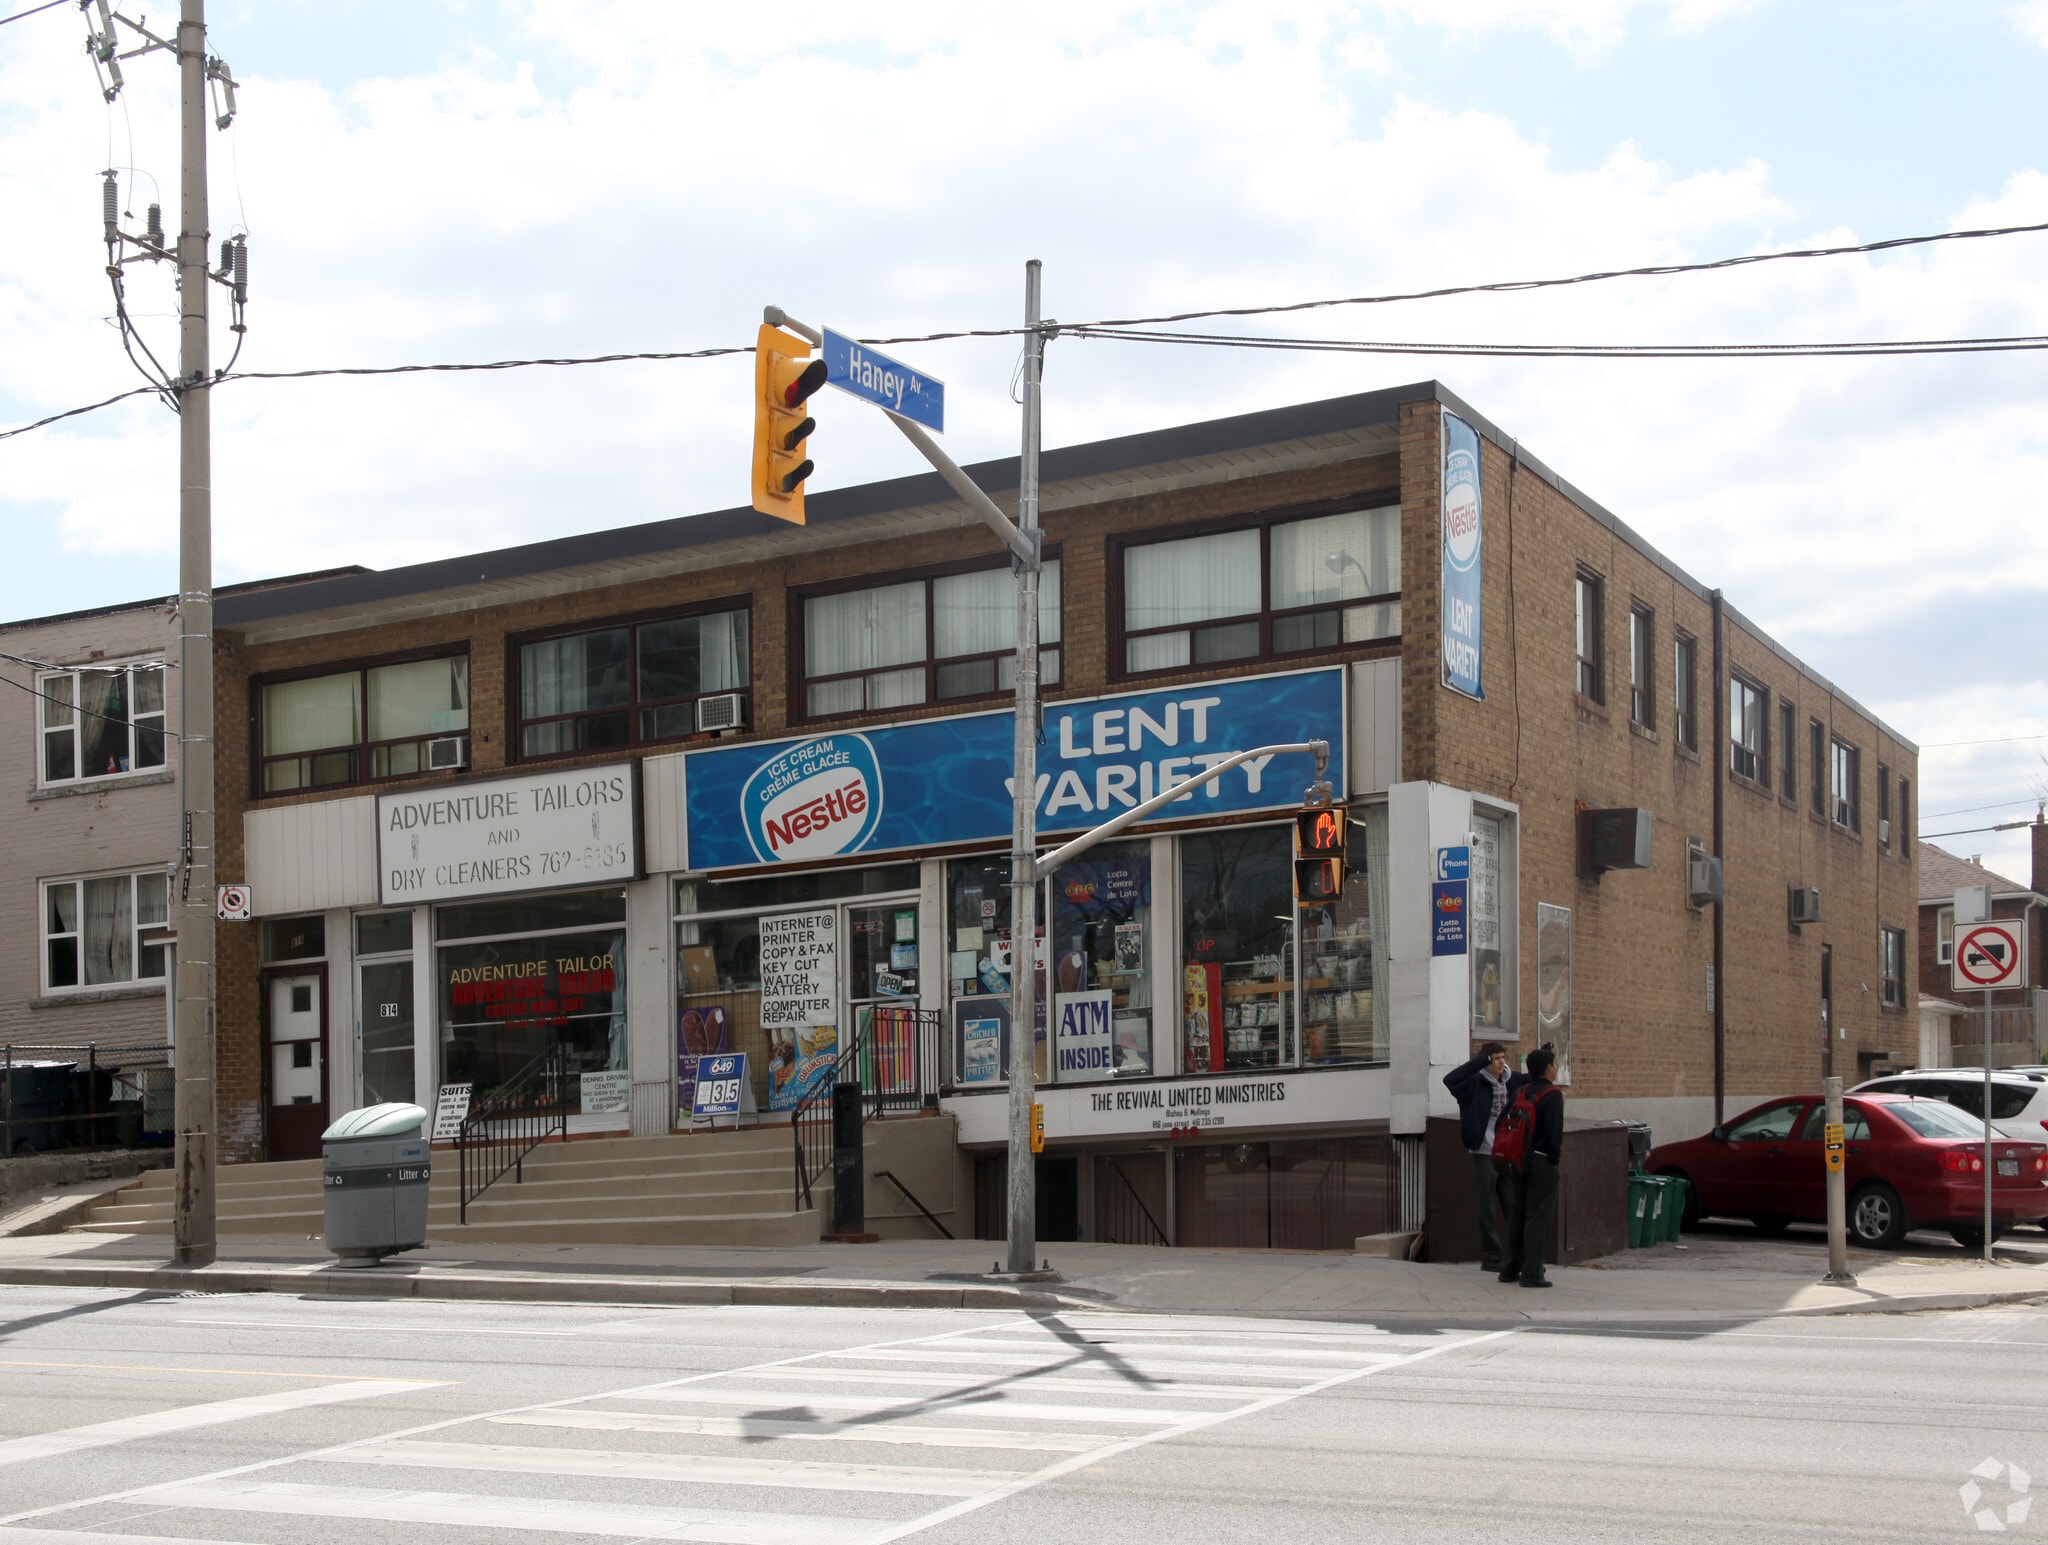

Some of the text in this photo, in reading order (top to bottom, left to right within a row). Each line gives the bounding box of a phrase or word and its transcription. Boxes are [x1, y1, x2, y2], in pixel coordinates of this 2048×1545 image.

[849, 346, 921, 411] Haney Av
[1447, 501, 1477, 539] Nestlé
[1451, 595, 1472, 639] LENT
[1444, 633, 1479, 682] VARIETY
[1059, 696, 1221, 760] LENT
[767, 739, 834, 779] ICE CREAM
[760, 750, 850, 802] CRÈME GLACÉE
[1004, 750, 1275, 816] VARIETY
[390, 777, 624, 831] ADVENTURE TAILORS
[765, 779, 866, 851] Nestlé
[487, 828, 520, 846] AND
[1444, 859, 1467, 868] Phone
[391, 867, 426, 891] DRY
[435, 857, 531, 886] CLEANERS
[1107, 880, 1133, 888] Centre
[1107, 890, 1138, 899] de Loto
[1437, 898, 1463, 908] OLG
[761, 915, 834, 933] INTERNET@
[763, 931, 815, 946] PRINTER
[1447, 932, 1463, 940] Loto
[763, 943, 834, 960] COPY & FAX
[450, 954, 613, 985] ADVENTURE TAILOR
[763, 958, 819, 974] KEY CUT
[452, 969, 616, 1006] ADVENTURE TAILOR
[763, 973, 808, 986] WATCH
[881, 975, 902, 991] OPEN
[764, 983, 819, 997] BATTERY
[381, 1004, 397, 1016] 814
[486, 997, 585, 1018] CUSTOM MADE SUIT
[763, 998, 830, 1012] COMPUTER
[763, 1010, 806, 1023] REPAIR
[1059, 1000, 1110, 1037] ATM
[967, 1029, 996, 1040] CHICKEN
[1060, 1046, 1110, 1071] INSIDE
[798, 1054, 836, 1083] DRUMSTICK
[967, 1065, 997, 1077] PATTIES
[441, 1086, 472, 1096] SUITS
[714, 1083, 737, 1102] 3.5
[1091, 1082, 1285, 1111] THE REVIVAL UNITED MINISTRIES
[770, 1096, 797, 1110] Essayez
[1166, 1109, 1183, 1118] Bishop
[1190, 1108, 1210, 1117] Mullings
[399, 1169, 418, 1181] Litter
